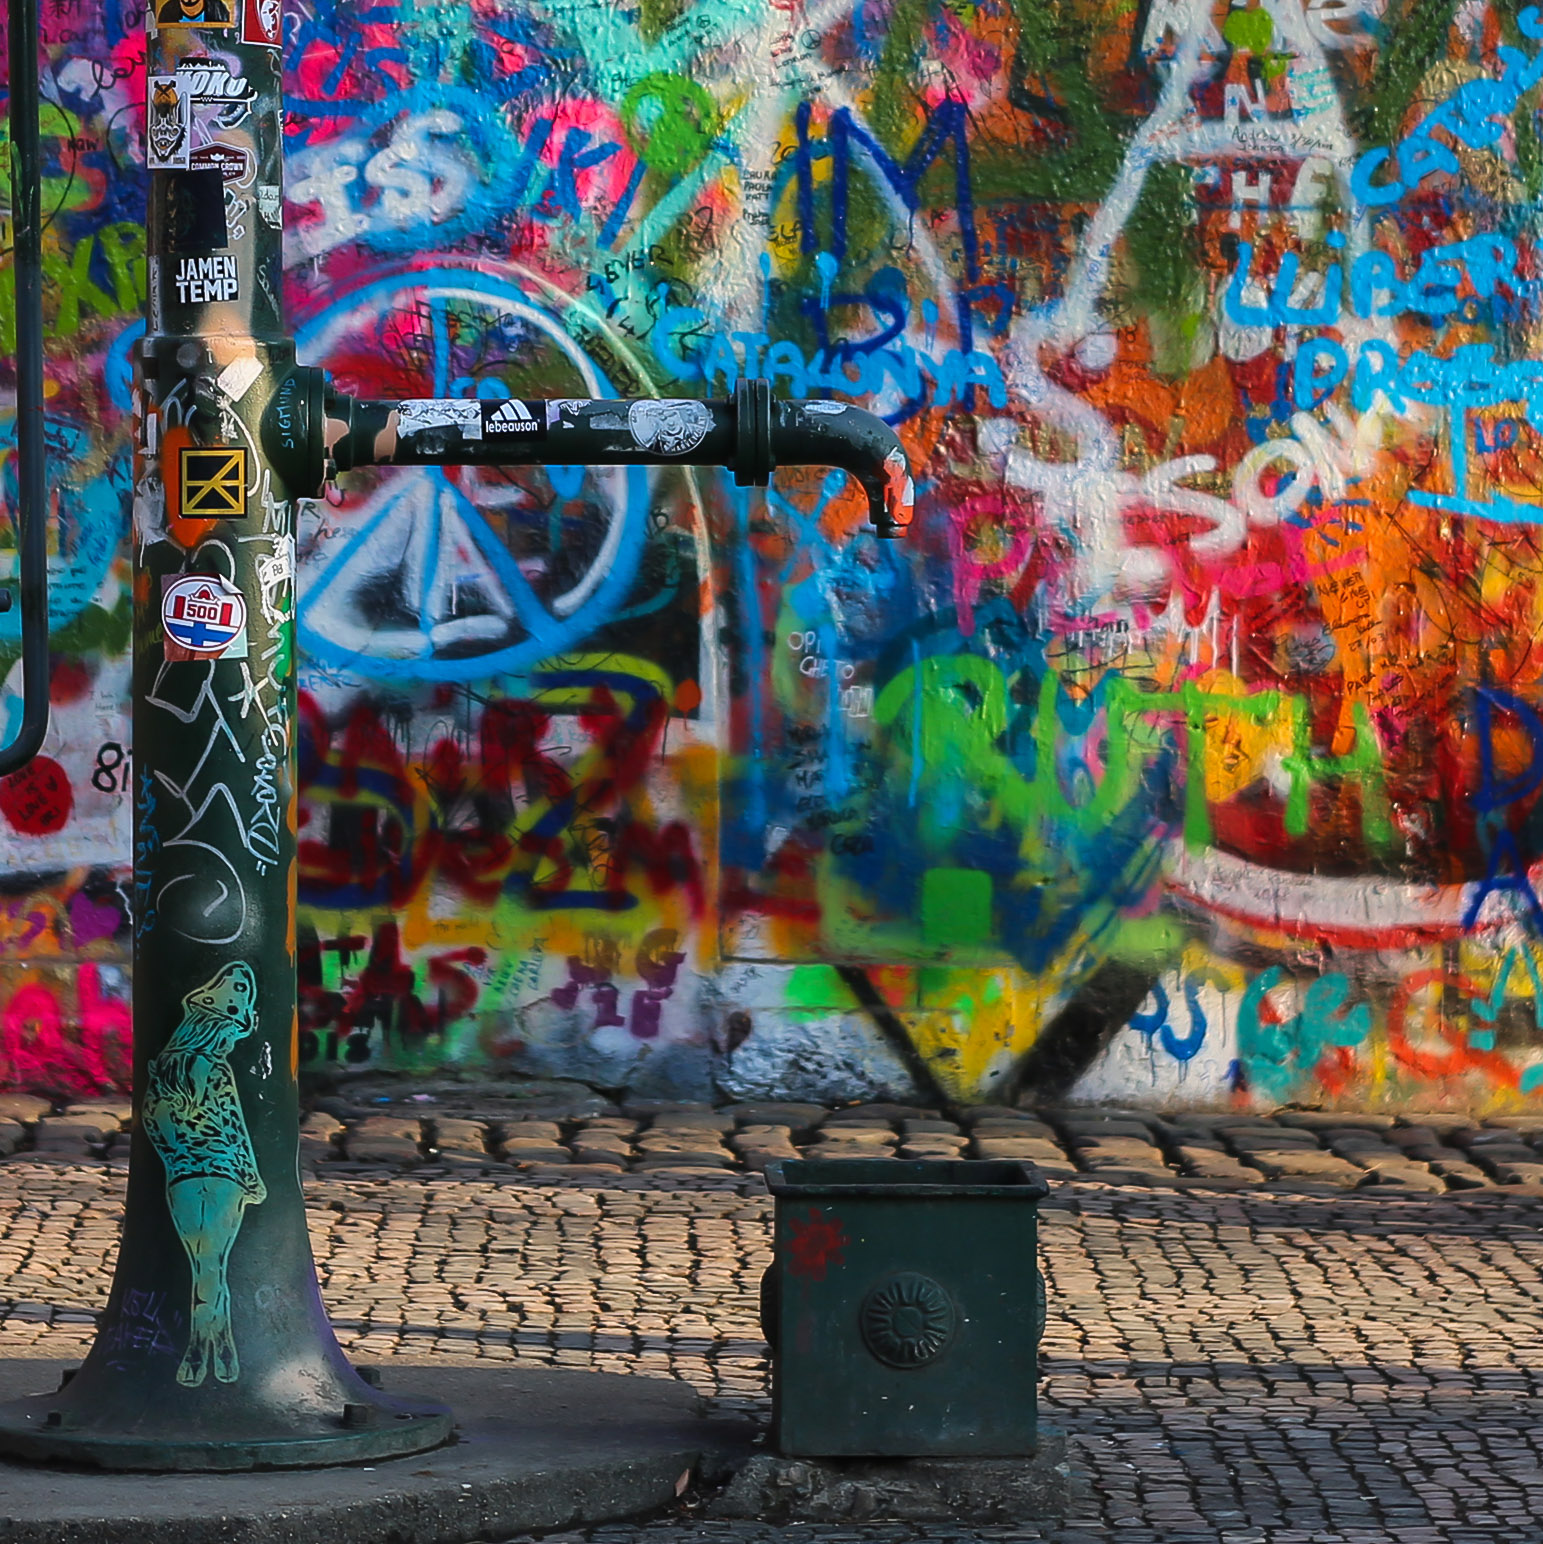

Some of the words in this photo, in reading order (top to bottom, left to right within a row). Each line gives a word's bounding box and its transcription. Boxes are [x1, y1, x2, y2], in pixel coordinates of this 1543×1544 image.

[175, 256, 237, 280] JAMEN
[175, 279, 239, 304] TEMP
[279, 375, 297, 450] SIGMUND
[186, 603, 217, 621] 500
